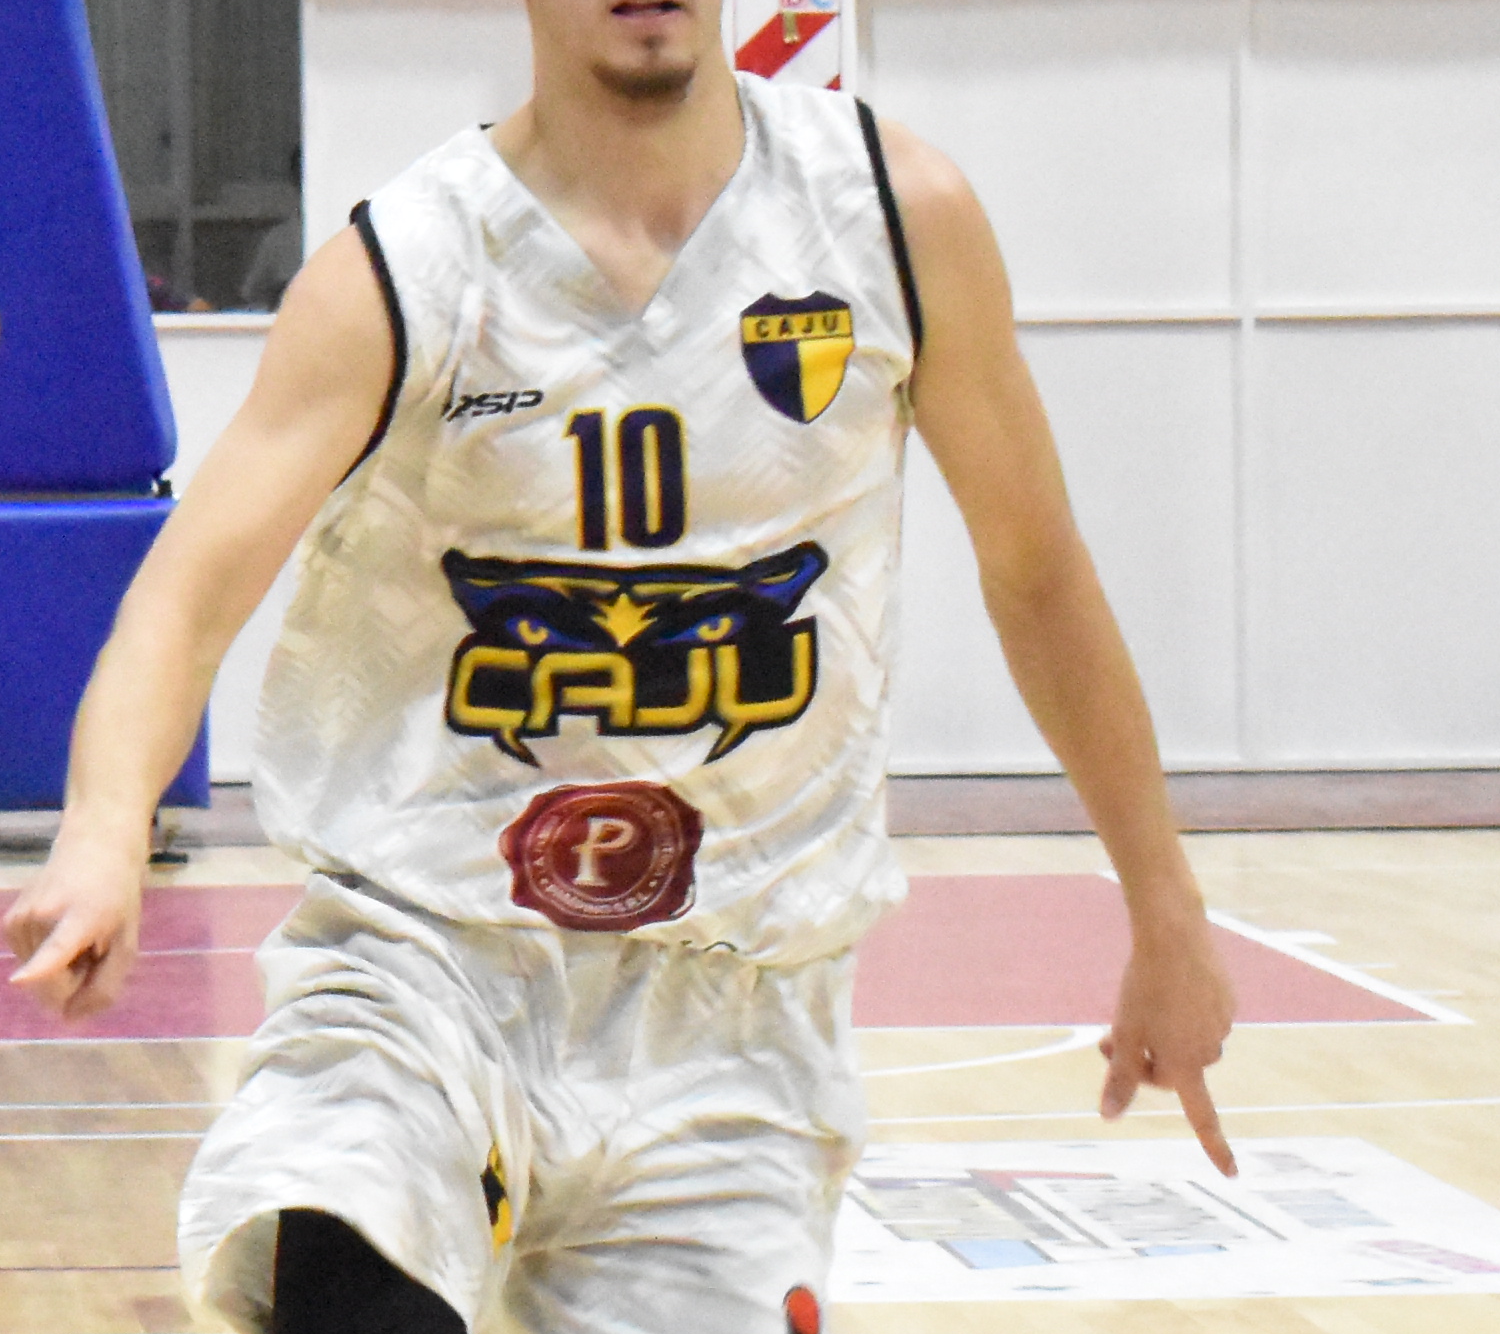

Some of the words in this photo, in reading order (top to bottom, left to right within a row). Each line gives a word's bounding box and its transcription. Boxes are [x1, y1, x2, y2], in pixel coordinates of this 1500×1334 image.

[755, 313, 838, 338] CAJU
[566, 404, 688, 551] 10
[447, 625, 816, 741] CAJU
[572, 816, 638, 887] P
